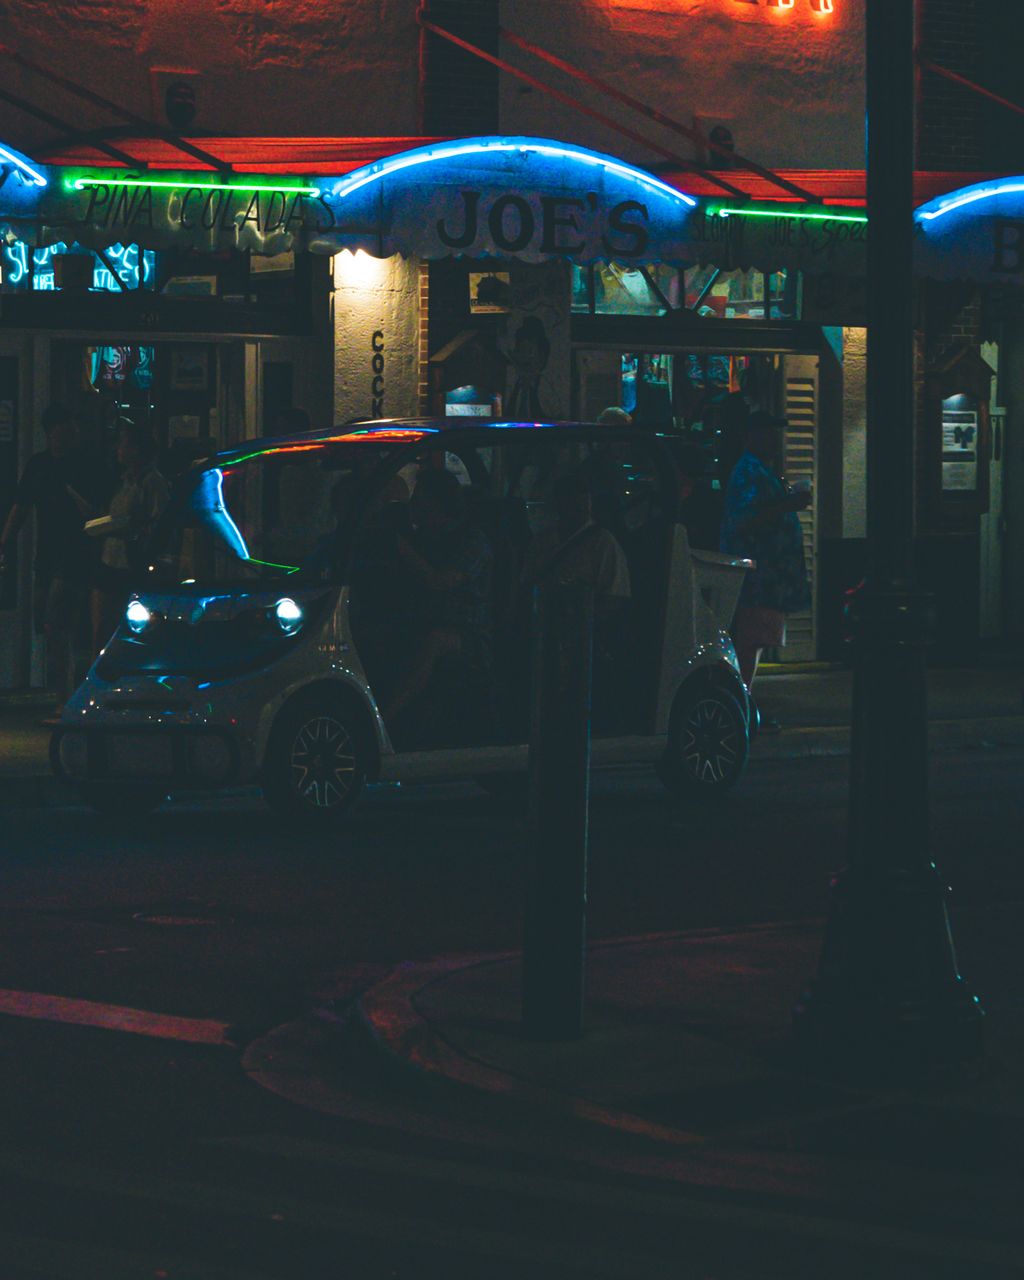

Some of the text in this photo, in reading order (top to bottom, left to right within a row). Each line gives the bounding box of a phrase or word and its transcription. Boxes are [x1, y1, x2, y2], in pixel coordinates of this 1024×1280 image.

[82, 173, 337, 232] PIÑA COLADAS
[436, 190, 650, 258] JOE'S
